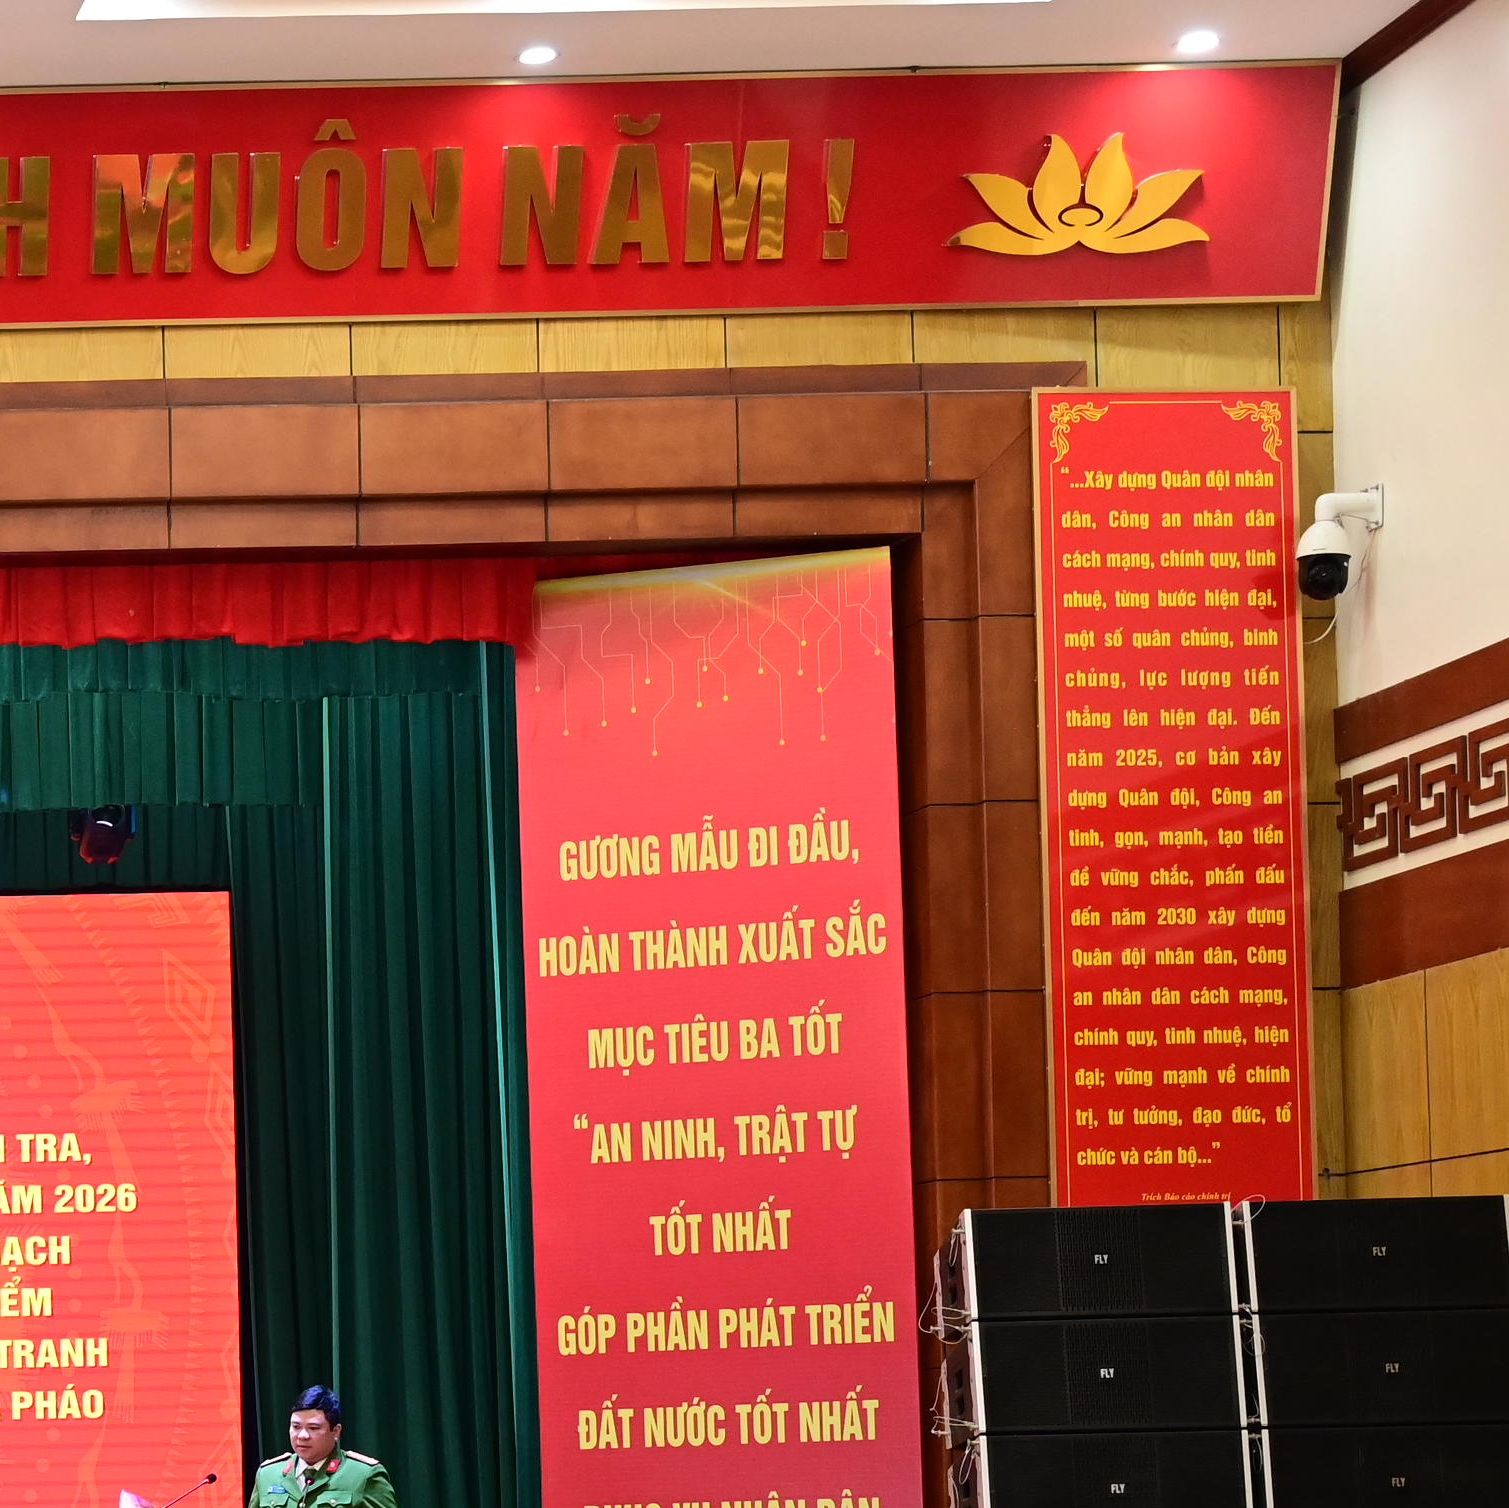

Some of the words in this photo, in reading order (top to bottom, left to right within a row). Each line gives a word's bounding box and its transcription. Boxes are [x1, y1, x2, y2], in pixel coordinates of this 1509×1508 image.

[90, 118, 464, 276] MUÔN
[1061, 510, 1097, 530] dân,
[1108, 509, 1150, 530] Công
[1161, 512, 1182, 528] an
[1193, 509, 1234, 527] nhân
[1245, 508, 1275, 527] dân
[1062, 549, 1102, 568] cách
[1106, 552, 1155, 572] mạng,
[1160, 549, 1205, 568] chính
[1209, 552, 1241, 569] quy,
[1245, 549, 1276, 567] tinh
[1066, 748, 1104, 767] năm
[1115, 748, 1163, 768] 2025,
[1175, 750, 1197, 766] cơ
[1208, 745, 1240, 766] bản
[1252, 747, 1282, 767] xây
[1070, 905, 1101, 927] đến
[1111, 907, 1146, 926] năm
[1157, 907, 1197, 925] 2030
[1207, 906, 1236, 927] xây
[1246, 906, 1286, 928] dựng
[538, 925, 620, 978] HOÀN
[628, 919, 728, 971] THÀNH
[737, 904, 816, 964] XUẤT
[825, 899, 887, 958] SẮC
[587, 1025, 655, 1077] MỤC
[663, 1013, 729, 1064] TIÊU
[739, 1017, 781, 1060] BA
[788, 1005, 843, 1057] TỐT
[15, 1132, 92, 1165] TRA,
[1100, 1368, 1114, 1378] FLY
[577, 1396, 634, 1450] ĐẤT
[643, 1396, 726, 1448] NƯỚC
[735, 1389, 789, 1445] TỐT
[798, 1385, 880, 1443] NHẤT
